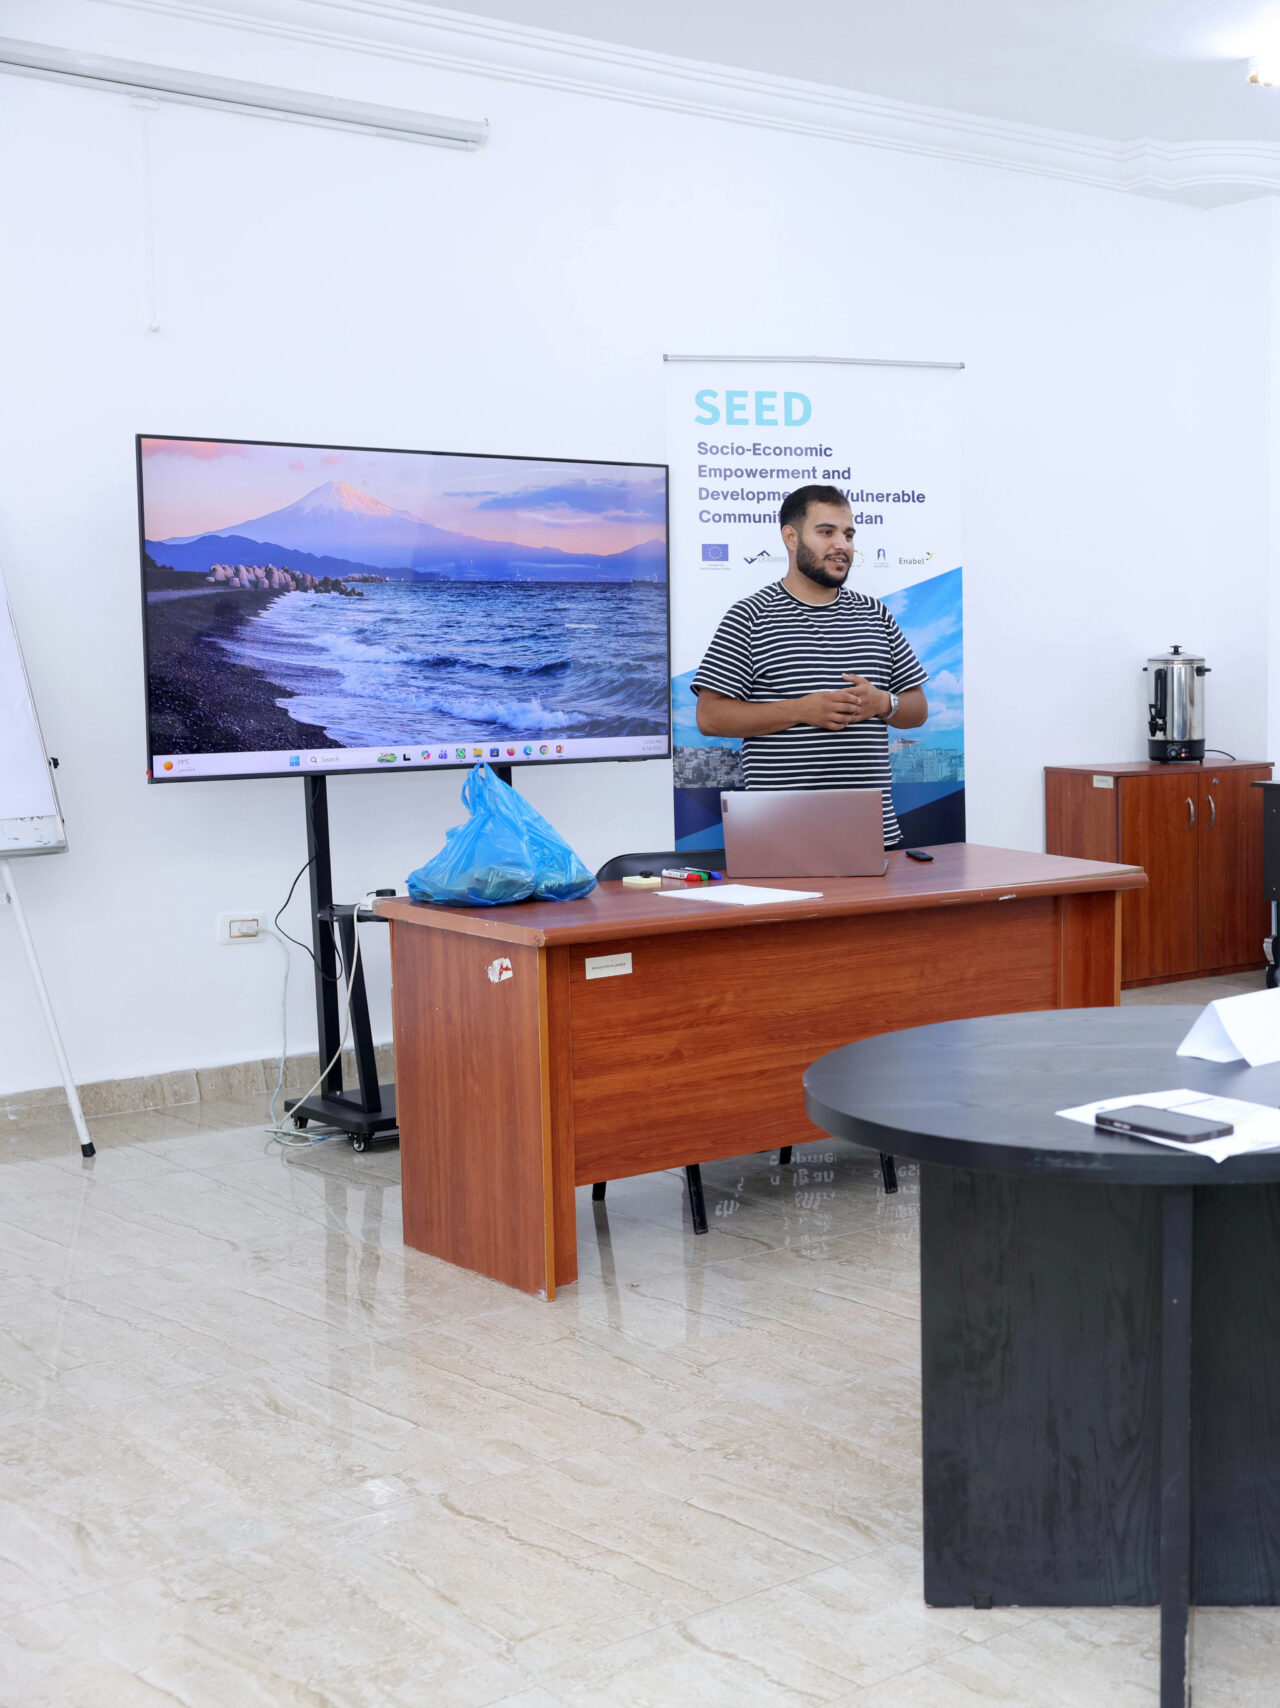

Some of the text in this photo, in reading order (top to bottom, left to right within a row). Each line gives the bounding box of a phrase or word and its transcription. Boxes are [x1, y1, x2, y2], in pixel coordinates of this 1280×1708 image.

[694, 389, 812, 427] SEED
[697, 441, 833, 457] Socio-Economic
[698, 464, 852, 481] Empowerment and
[698, 487, 926, 504] Developme Vulnerable
[852, 511, 884, 525] dan
[898, 557, 925, 565] Enabel
